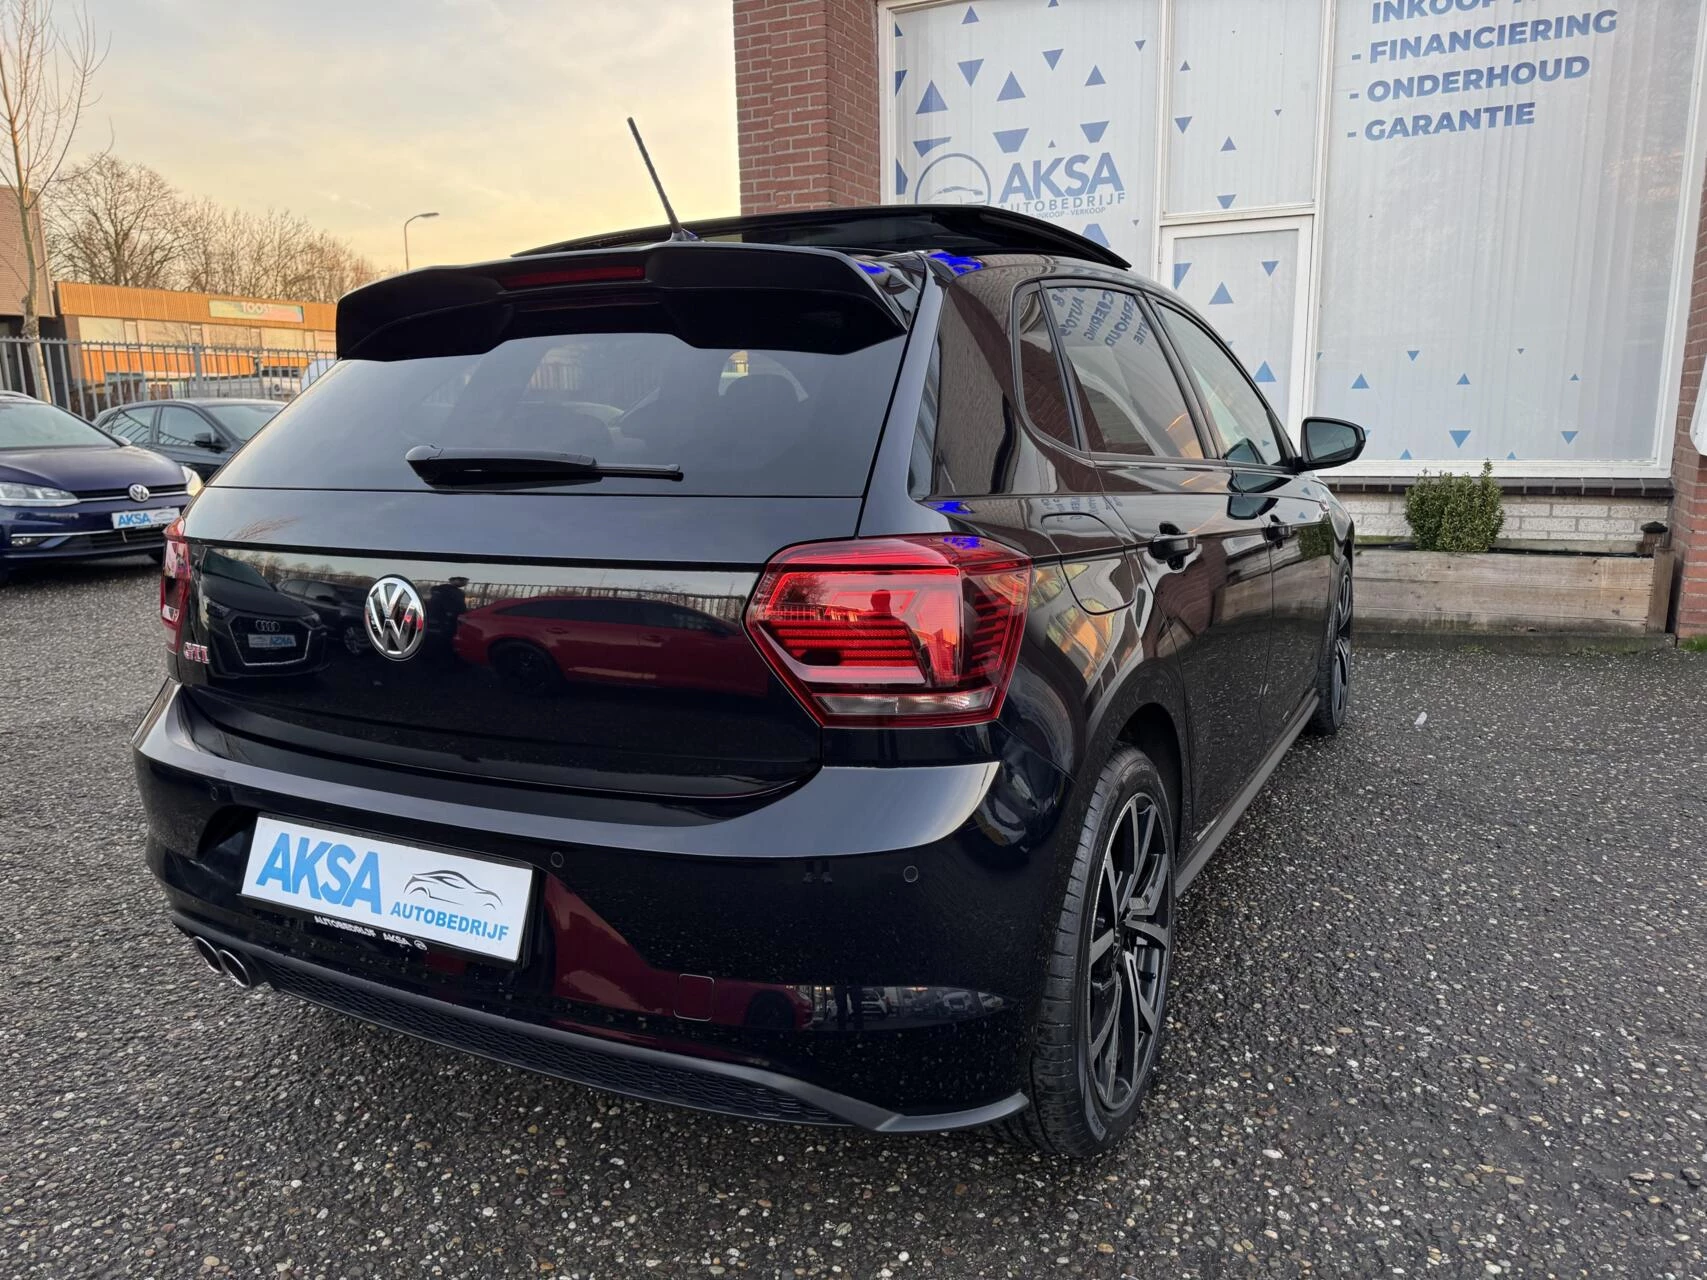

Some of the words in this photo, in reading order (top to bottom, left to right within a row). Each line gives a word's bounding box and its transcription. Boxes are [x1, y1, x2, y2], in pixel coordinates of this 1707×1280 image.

[1369, 9, 1618, 64] FINANCIERING
[1366, 55, 1591, 102] ONDERHOUD
[1364, 102, 1536, 141] GARANTIE
[998, 152, 1125, 203] AKSA
[1070, 206, 1106, 217] VERKOOP
[118, 512, 152, 526] AKSA
[184, 641, 210, 665] GTI
[256, 832, 382, 915] AKSA
[314, 915, 376, 937] AUTOBEDRIJF
[382, 932, 413, 947] AKSA
[390, 901, 509, 941] AUTOBEDRIJF
